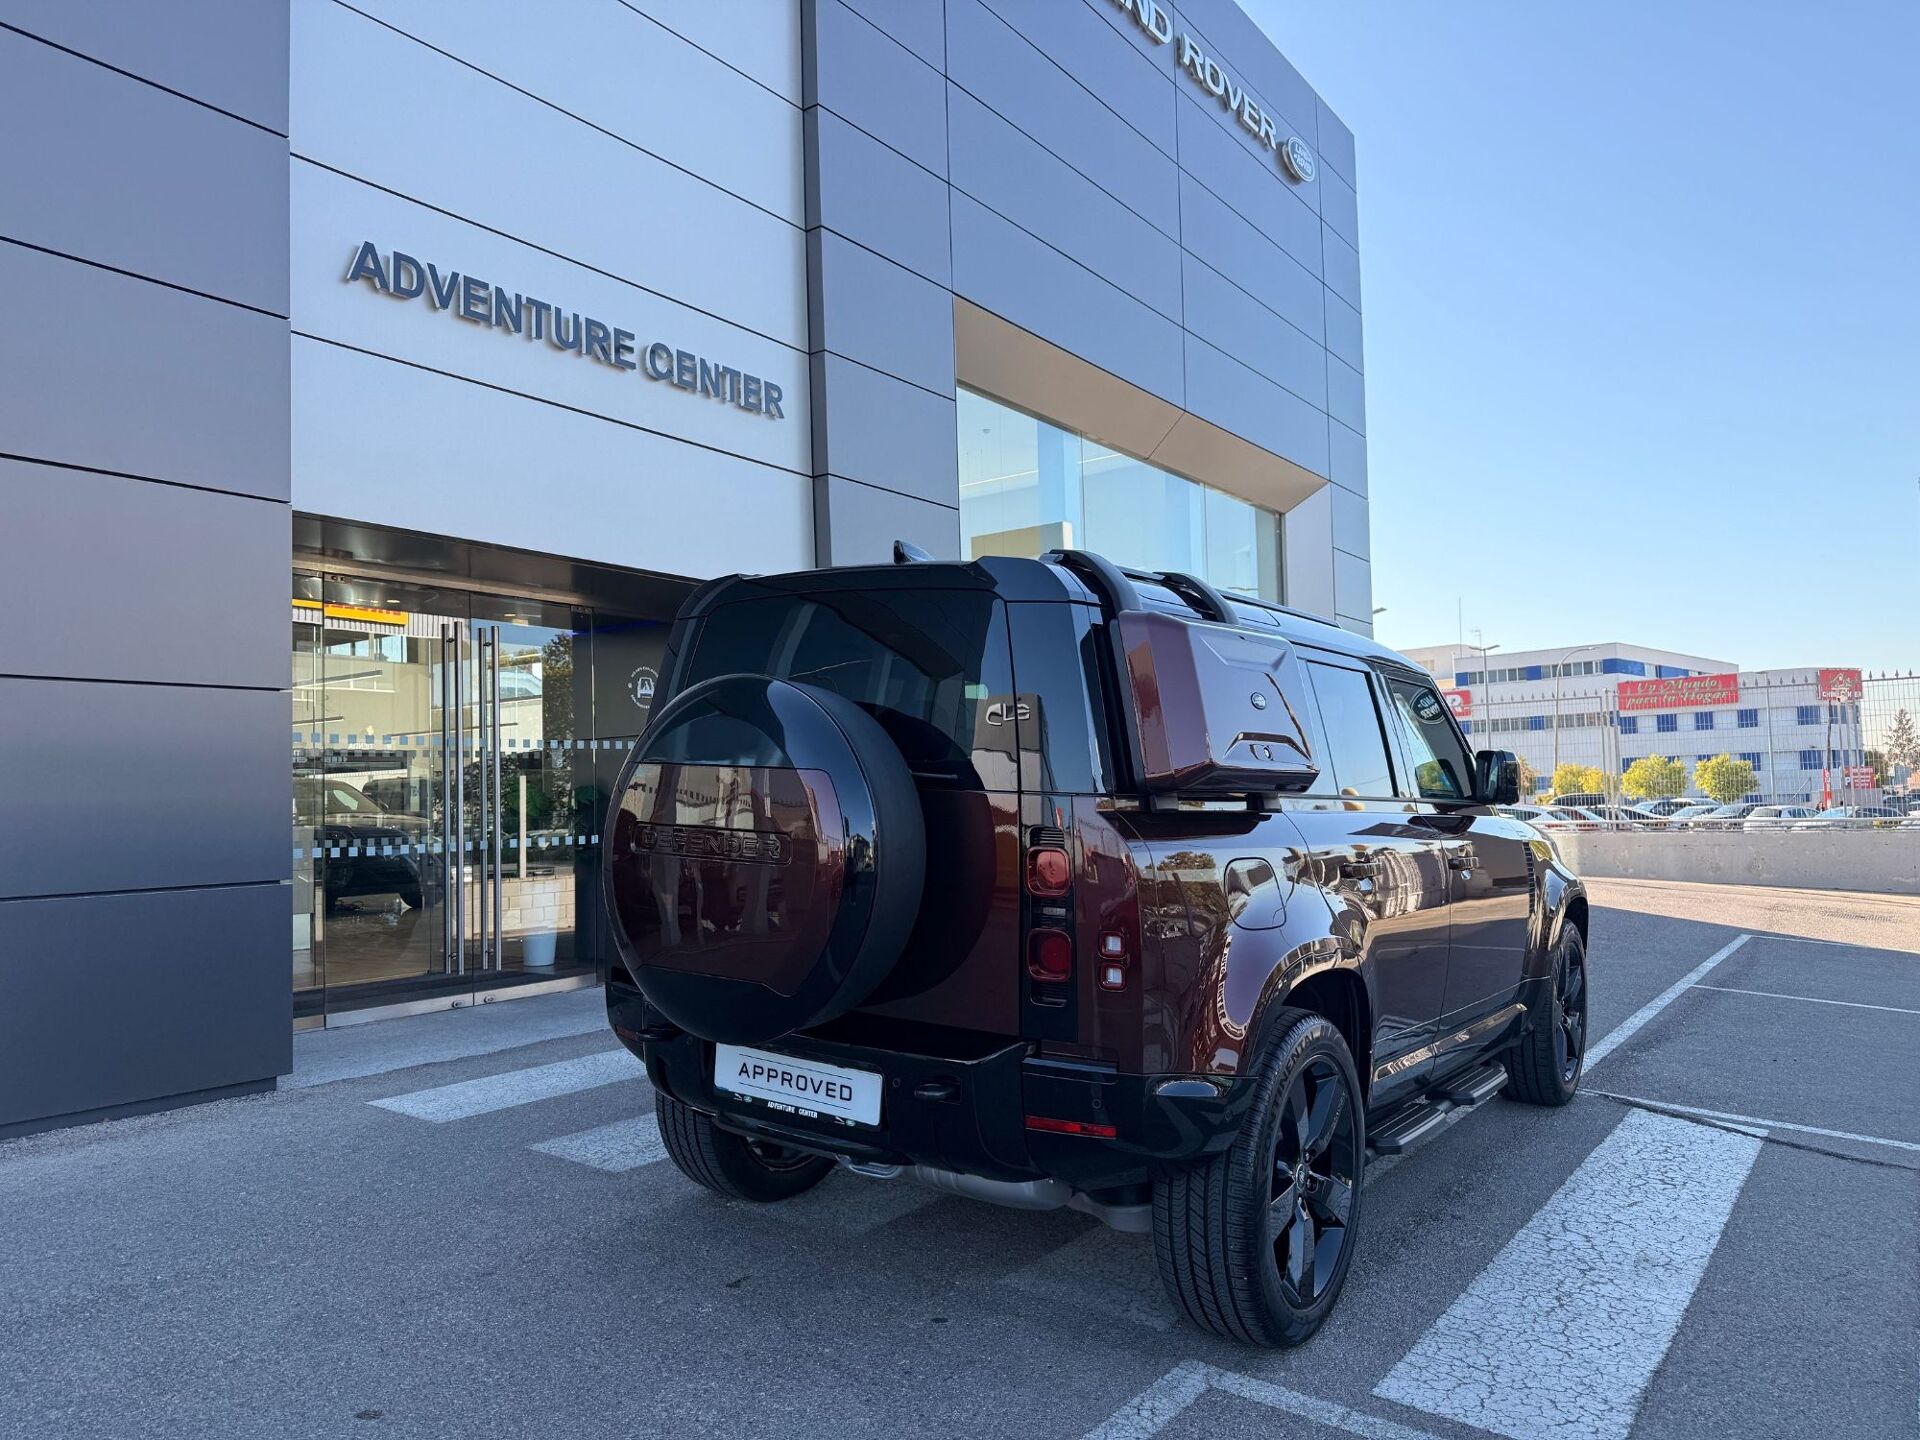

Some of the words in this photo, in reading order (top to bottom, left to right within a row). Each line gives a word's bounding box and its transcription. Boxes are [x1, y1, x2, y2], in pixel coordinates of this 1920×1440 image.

[1179, 32, 1277, 150] ROVER
[346, 240, 637, 371] ADVENTURE
[645, 341, 785, 420] CENTER
[641, 826, 782, 860] DEFENDER
[738, 1062, 853, 1102] APPROVED
[767, 1100, 796, 1115] ADVENTURE
[798, 1107, 819, 1120] CENTER
